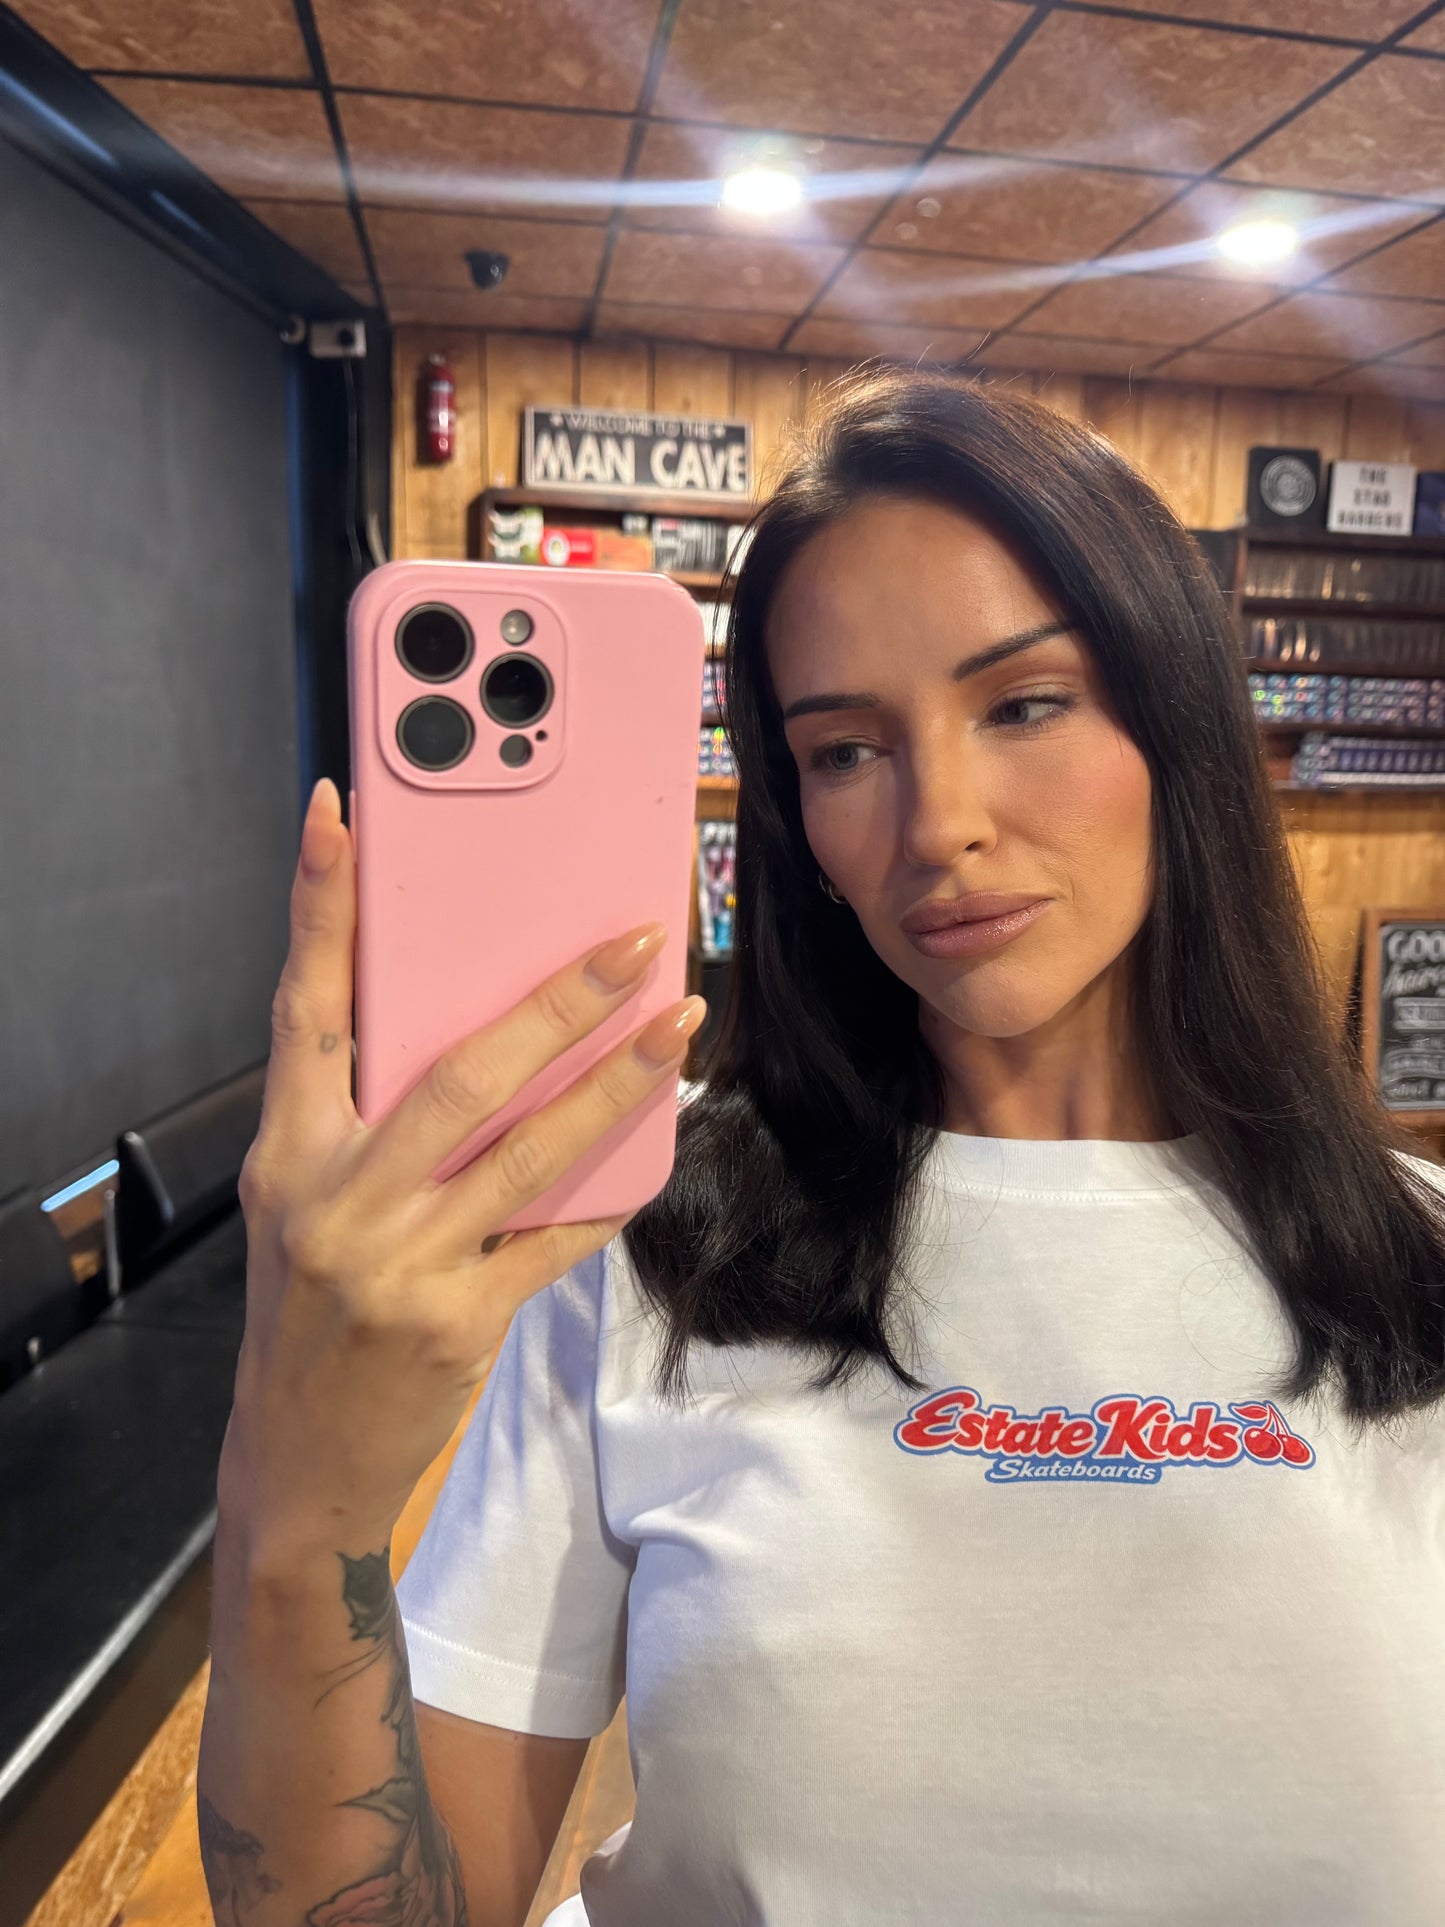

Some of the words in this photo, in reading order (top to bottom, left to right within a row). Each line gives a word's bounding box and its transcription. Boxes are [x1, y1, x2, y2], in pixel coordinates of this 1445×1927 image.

[568, 412, 653, 437] WELCOME
[655, 418, 680, 438] TO
[682, 420, 709, 441] THE
[535, 429, 636, 485] MAN
[650, 439, 746, 491] CAVE
[899, 1387, 1094, 1456] Estate
[1096, 1398, 1240, 1461] Kids
[990, 1458, 1157, 1481] Skateboards
